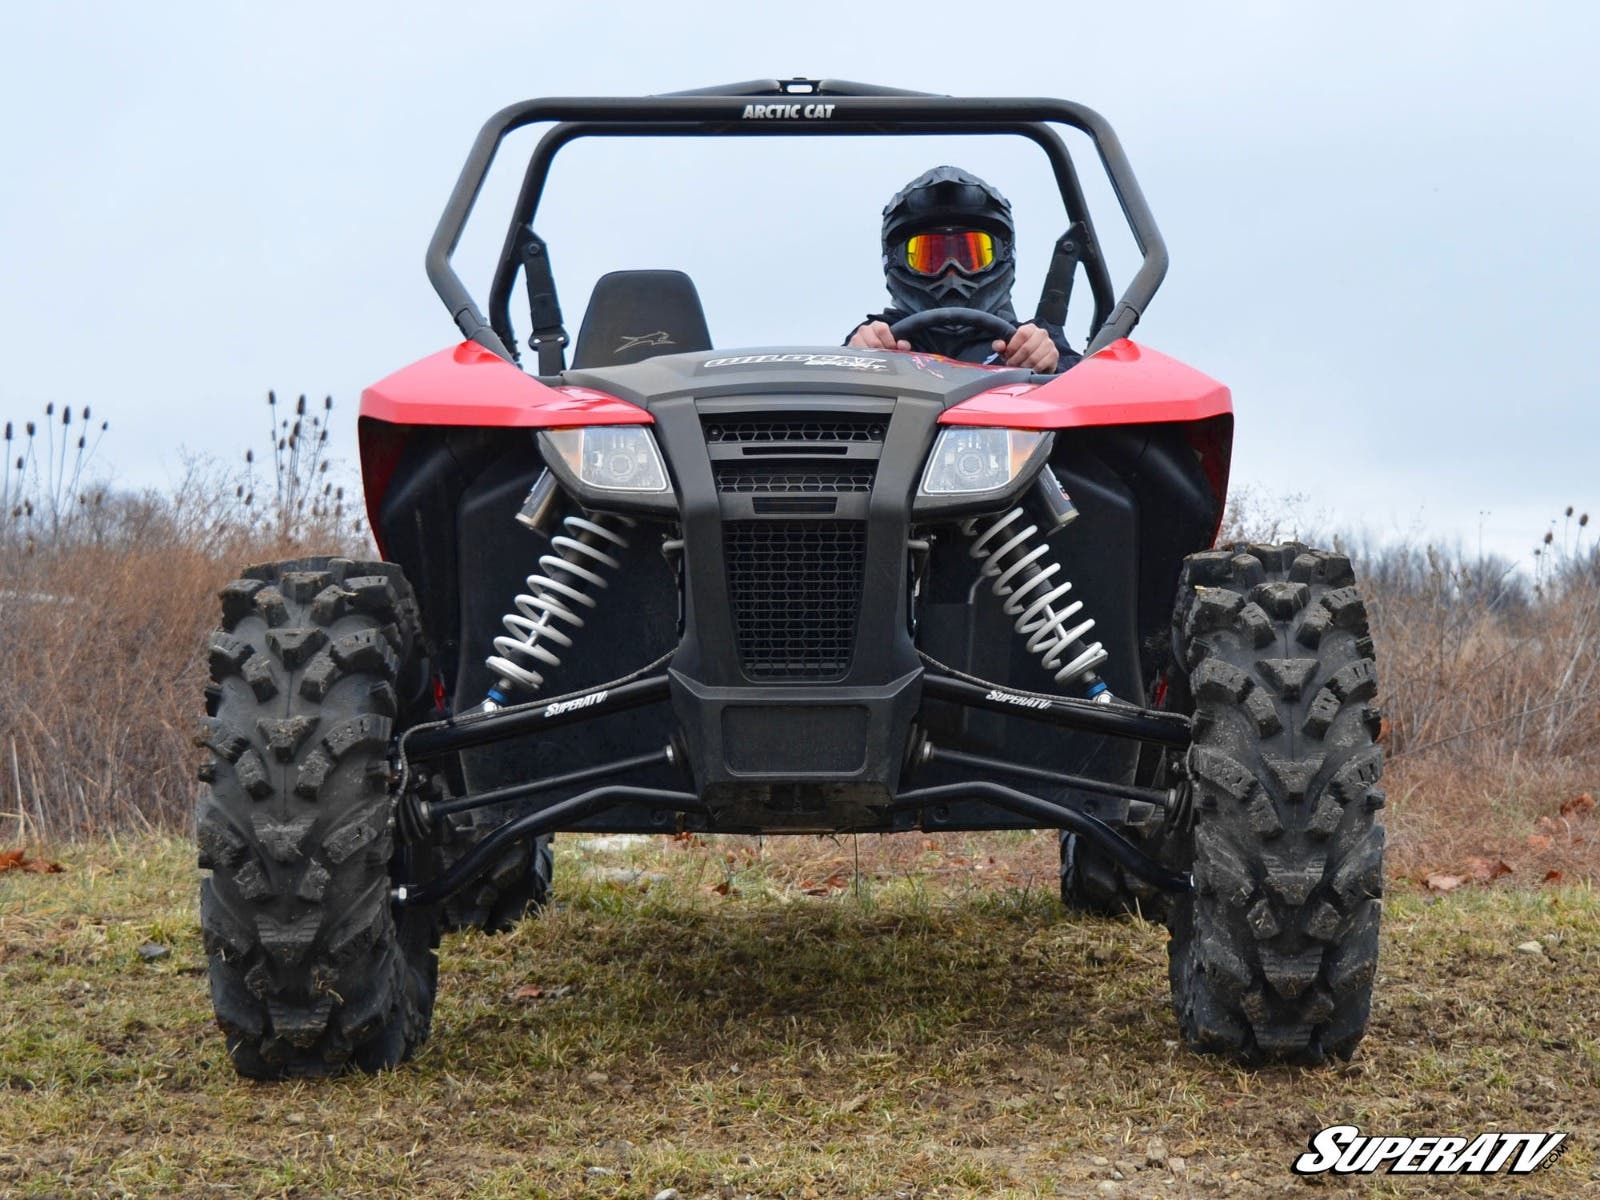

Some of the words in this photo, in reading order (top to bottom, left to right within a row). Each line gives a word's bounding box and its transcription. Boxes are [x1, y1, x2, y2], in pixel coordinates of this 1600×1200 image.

[743, 104, 801, 119] ARCTIC
[803, 104, 836, 119] CAT
[544, 690, 608, 717] SUPERATV
[985, 690, 1053, 709] SUPERATV
